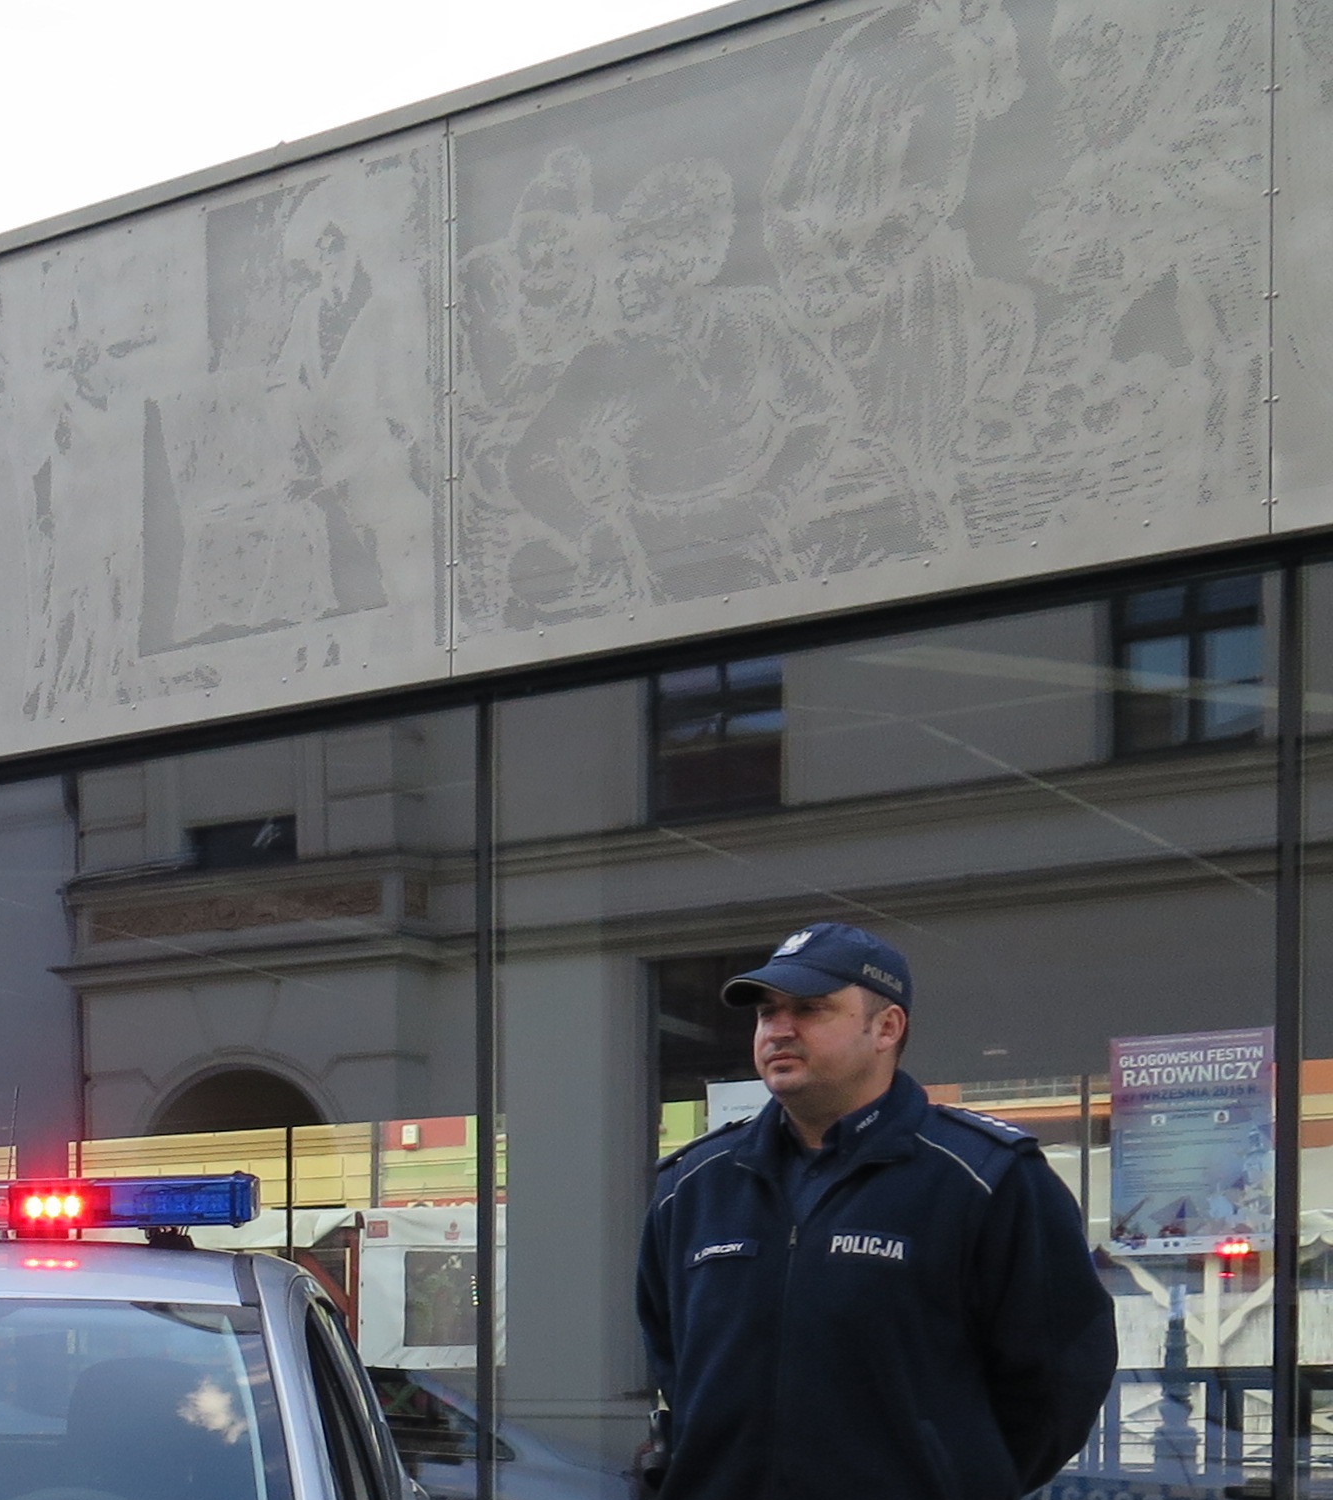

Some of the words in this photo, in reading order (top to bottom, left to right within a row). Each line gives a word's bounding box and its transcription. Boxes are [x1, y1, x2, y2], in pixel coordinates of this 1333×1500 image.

[1119, 1051, 1204, 1068] GŁOGOWSKI
[1207, 1046, 1264, 1061] FESTYN
[1121, 1061, 1263, 1087] RATOWNICZY
[830, 1235, 904, 1260] POLICJA
